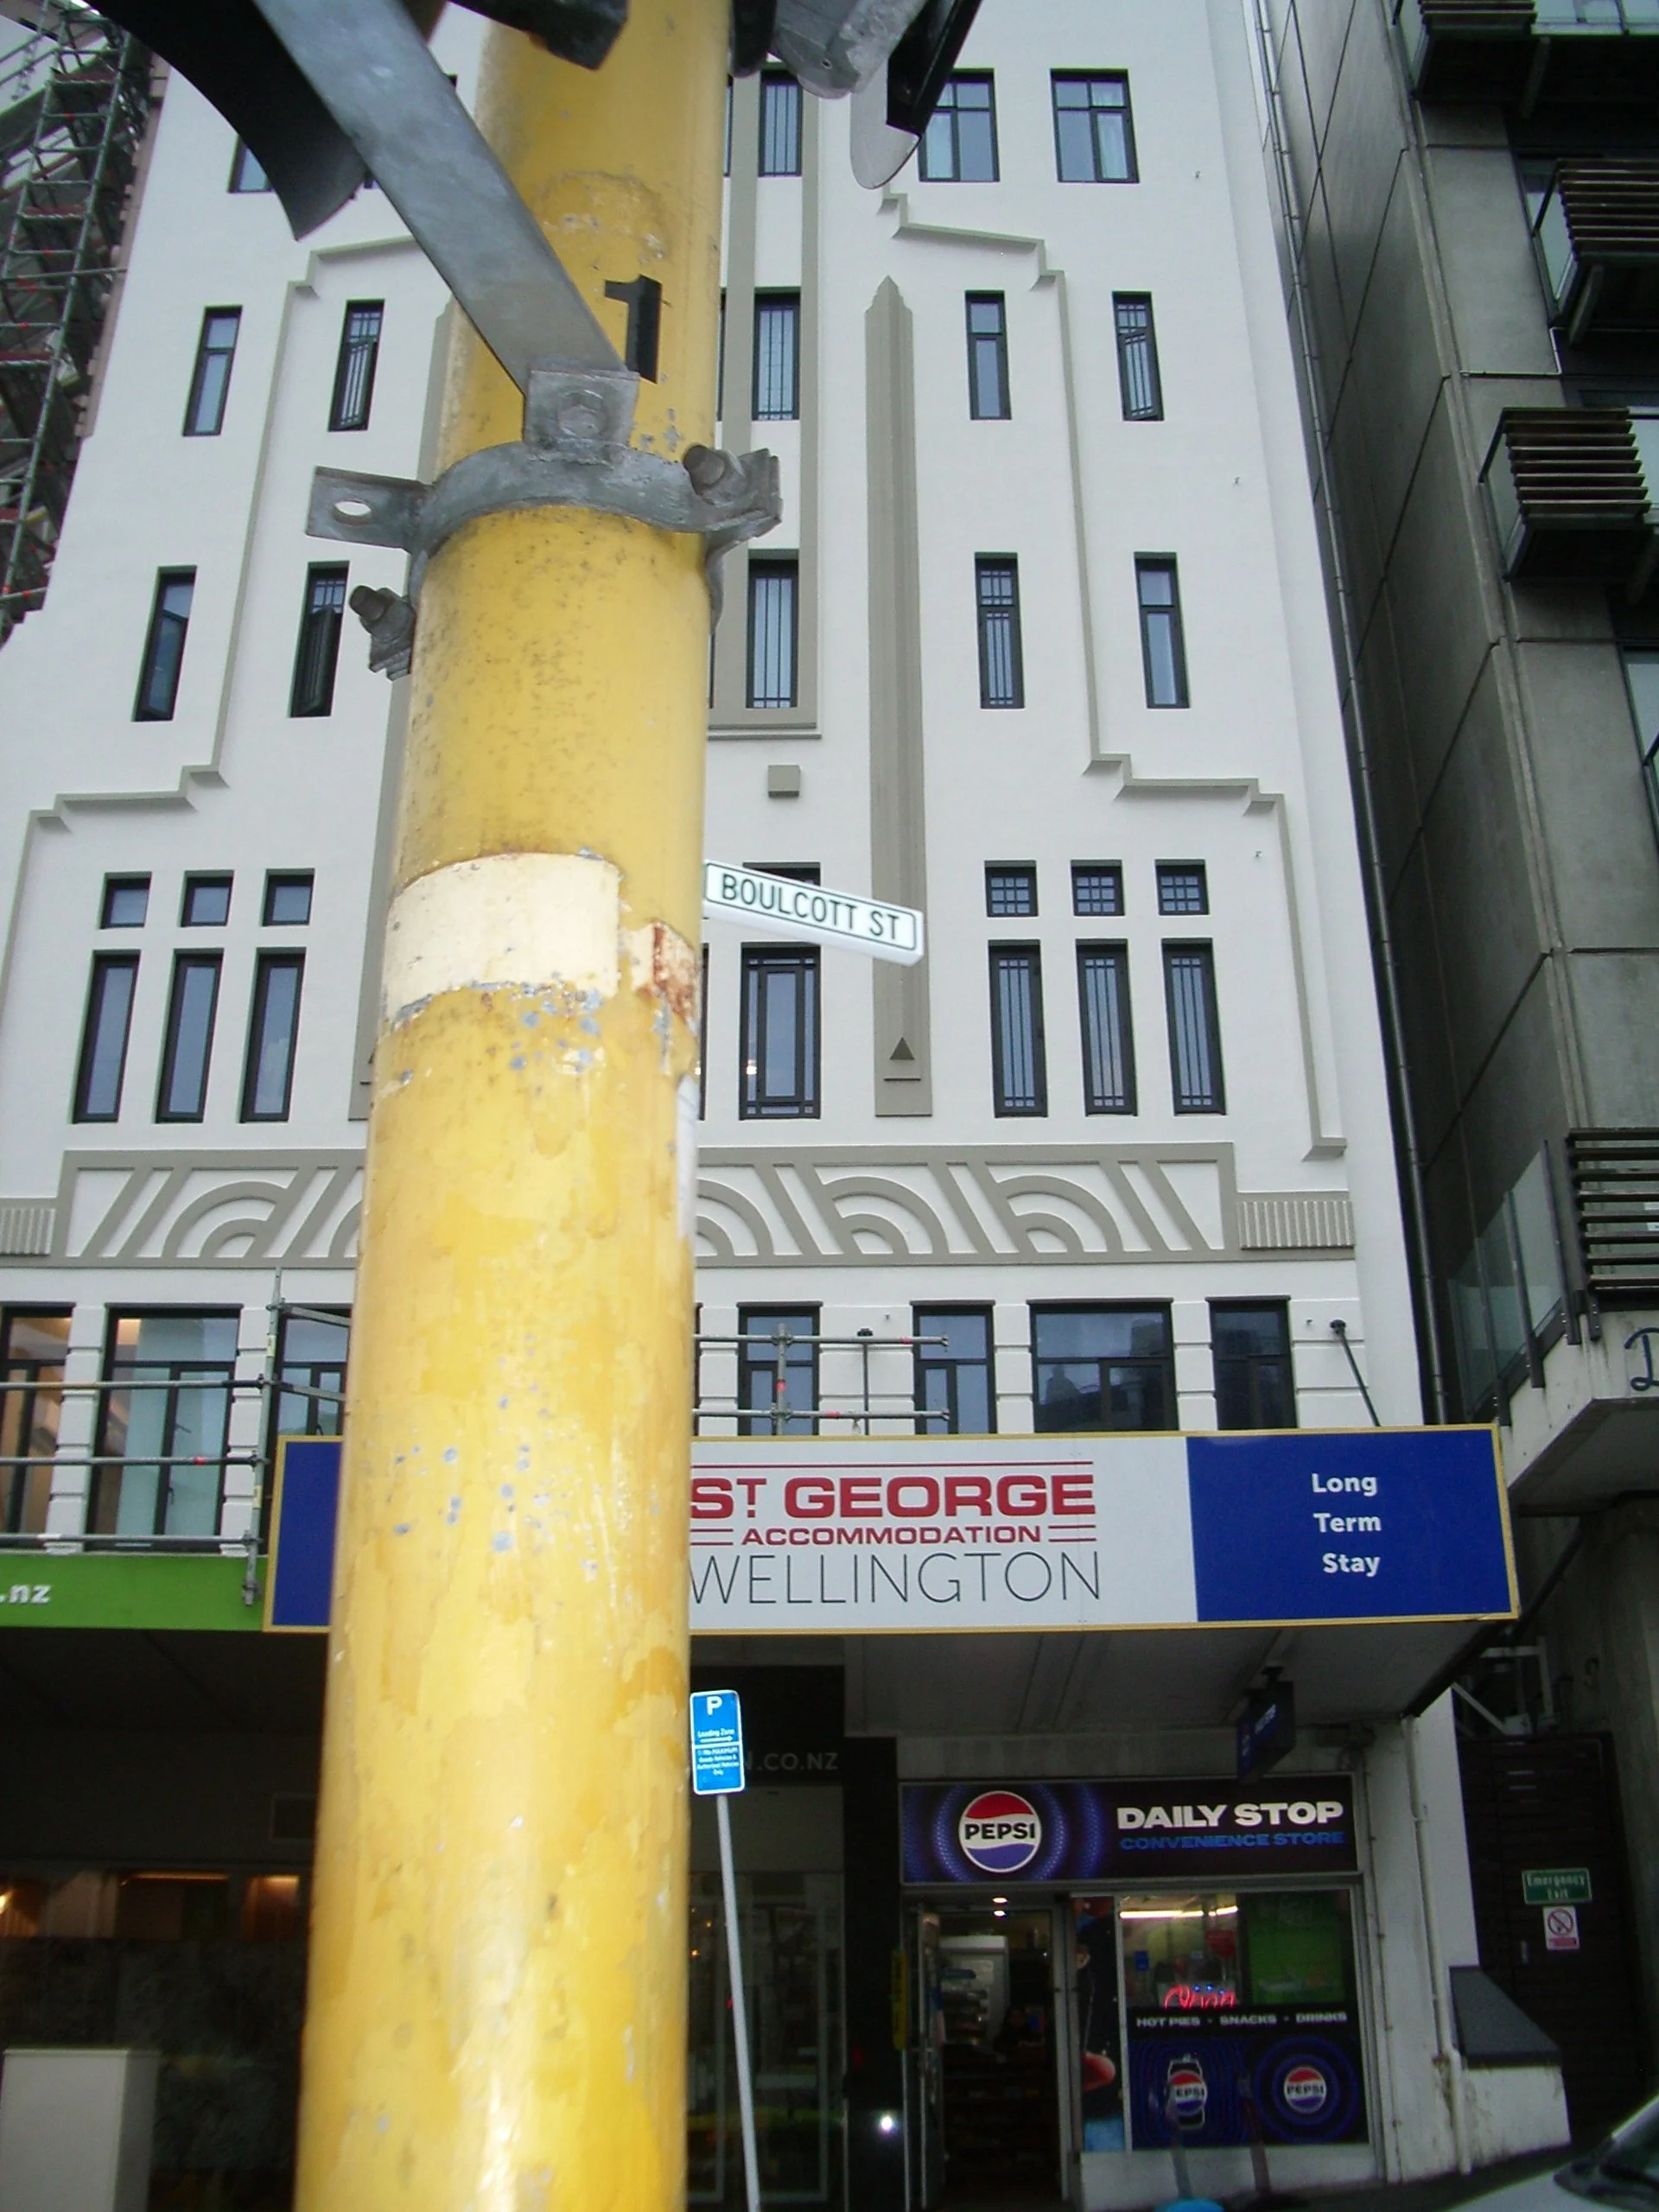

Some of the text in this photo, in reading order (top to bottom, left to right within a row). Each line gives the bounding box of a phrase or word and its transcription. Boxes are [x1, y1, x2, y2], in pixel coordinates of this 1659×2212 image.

[604, 273, 662, 384] 1
[721, 874, 902, 940] BOULCOTT ST
[1311, 1472, 1378, 1497] Long
[784, 1473, 1096, 1519] GEORGE
[1313, 1512, 1382, 1534] Term
[741, 1524, 1041, 1546] ACCOMMODATION
[1321, 1552, 1381, 1578] Stay
[688, 1550, 1101, 1605] WELLINGTON
[706, 1695, 723, 1715] P
[1116, 1801, 1344, 1830] DAILY STOP
[963, 1821, 1036, 1841] PEPSI
[1120, 1831, 1345, 1851] CONVENIENCE STORE
[1136, 2012, 1348, 2027] HOT PIES SNACKS DRINKS
[1176, 2088, 1205, 2097] EPSI
[1287, 2084, 1324, 2096] PEPSI
